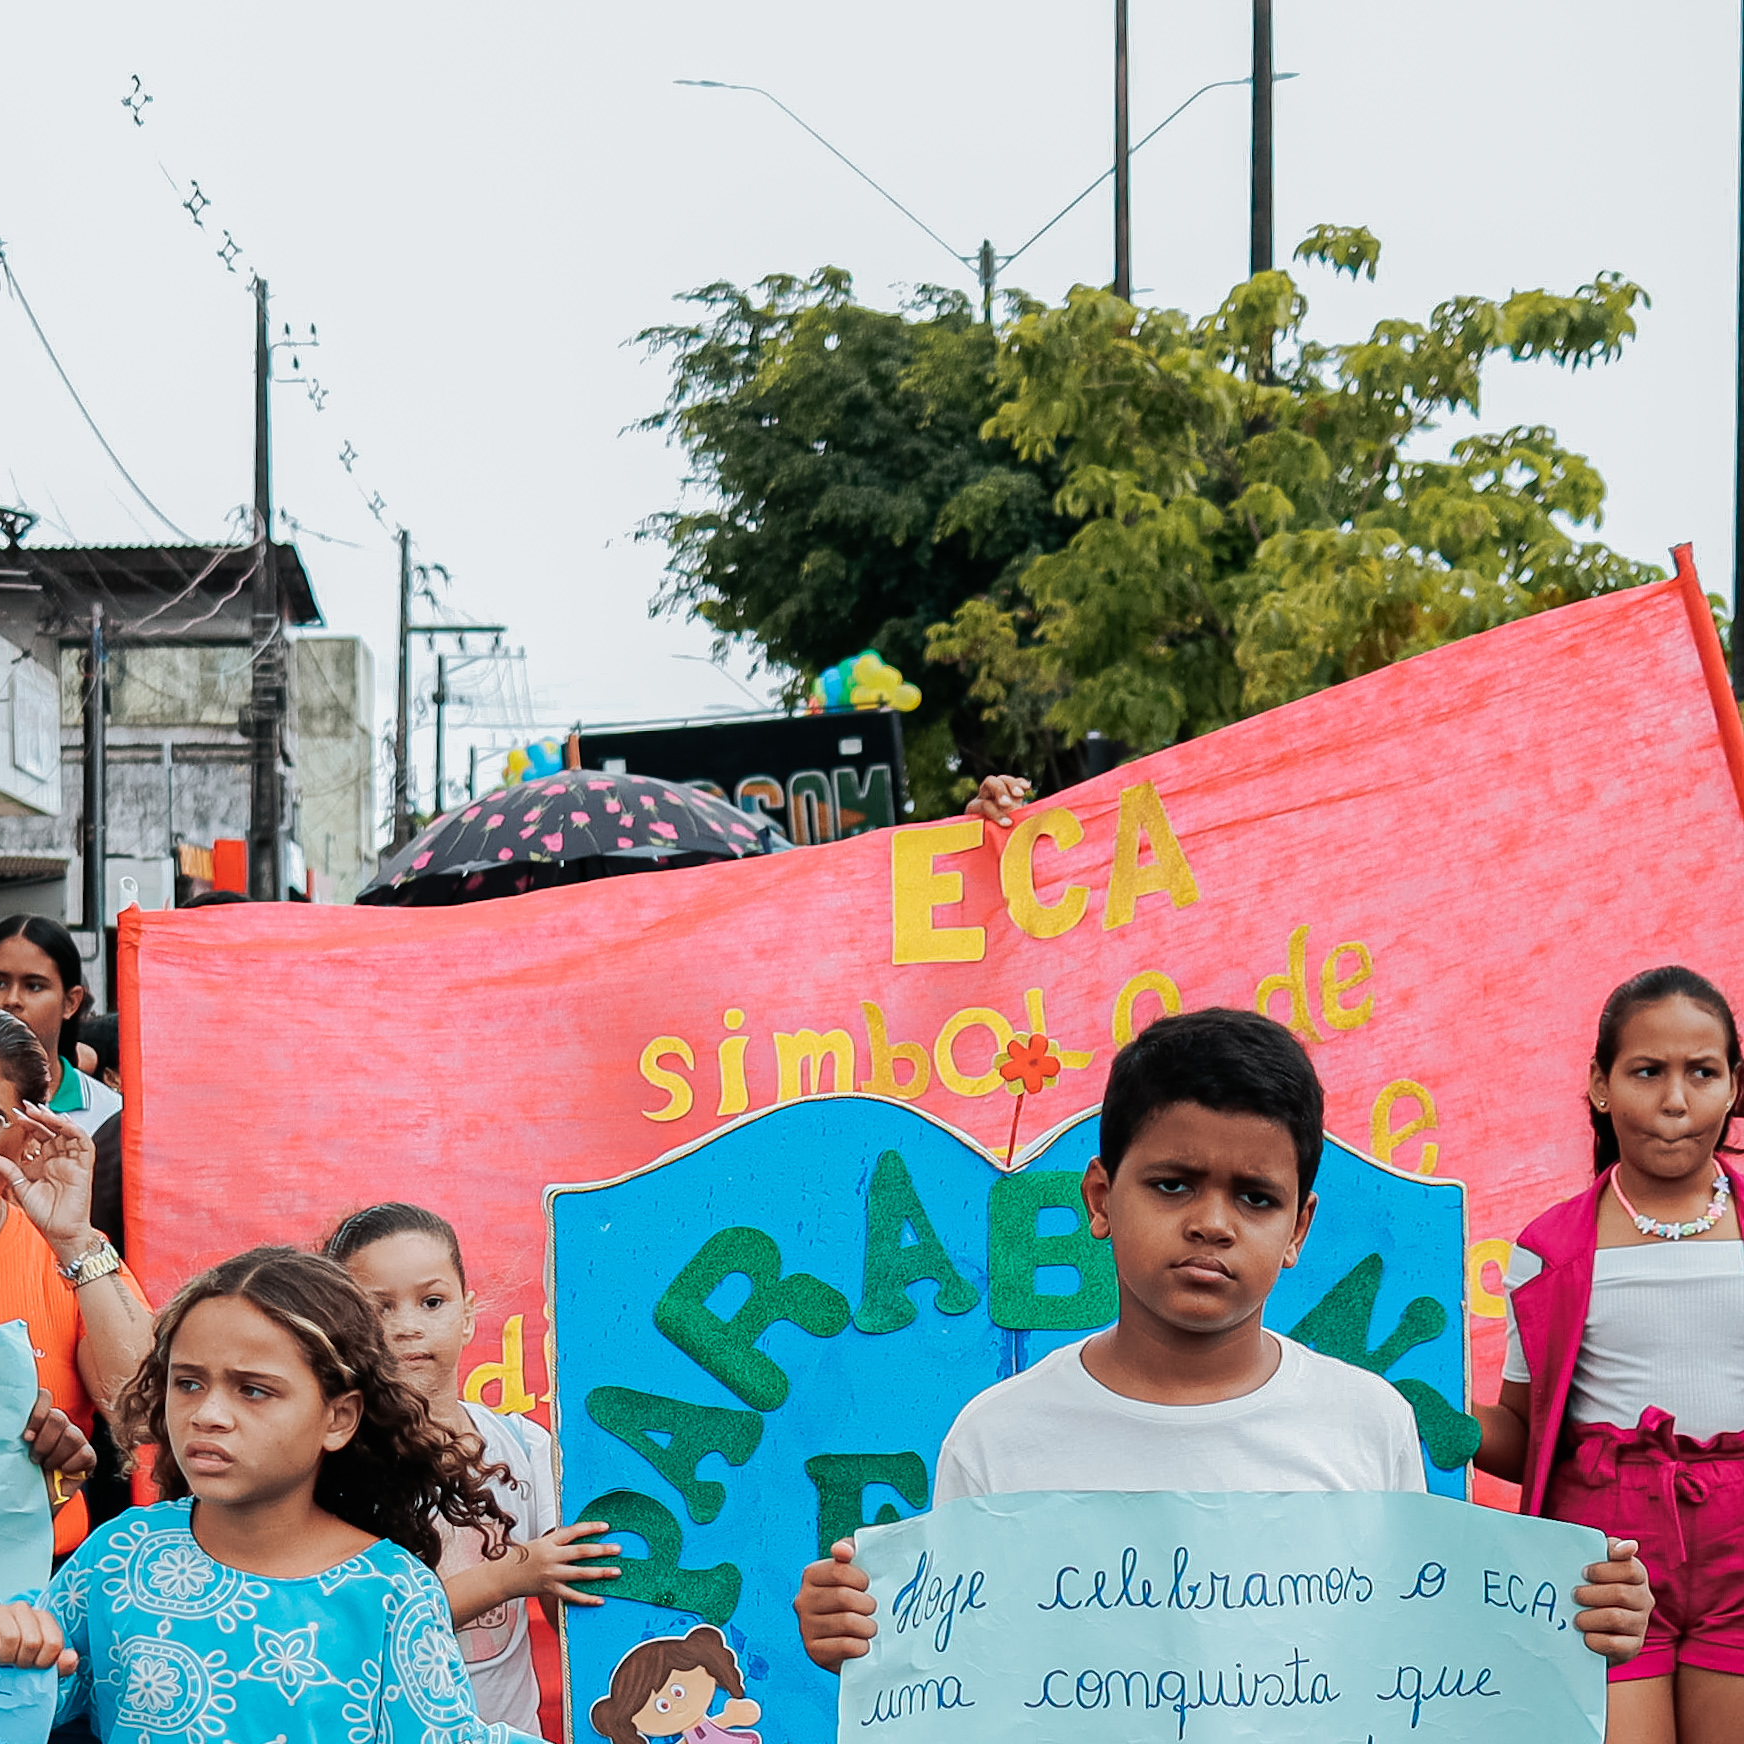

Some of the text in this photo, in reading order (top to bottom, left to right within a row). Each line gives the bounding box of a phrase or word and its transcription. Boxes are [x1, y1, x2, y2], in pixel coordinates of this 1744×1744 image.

[890, 779, 1202, 966] ECA
[1254, 924, 1374, 1043] de
[891, 1546, 1568, 1654] Hoje celebramos o ECA,
[860, 1647, 1502, 1742] uma conquista que
